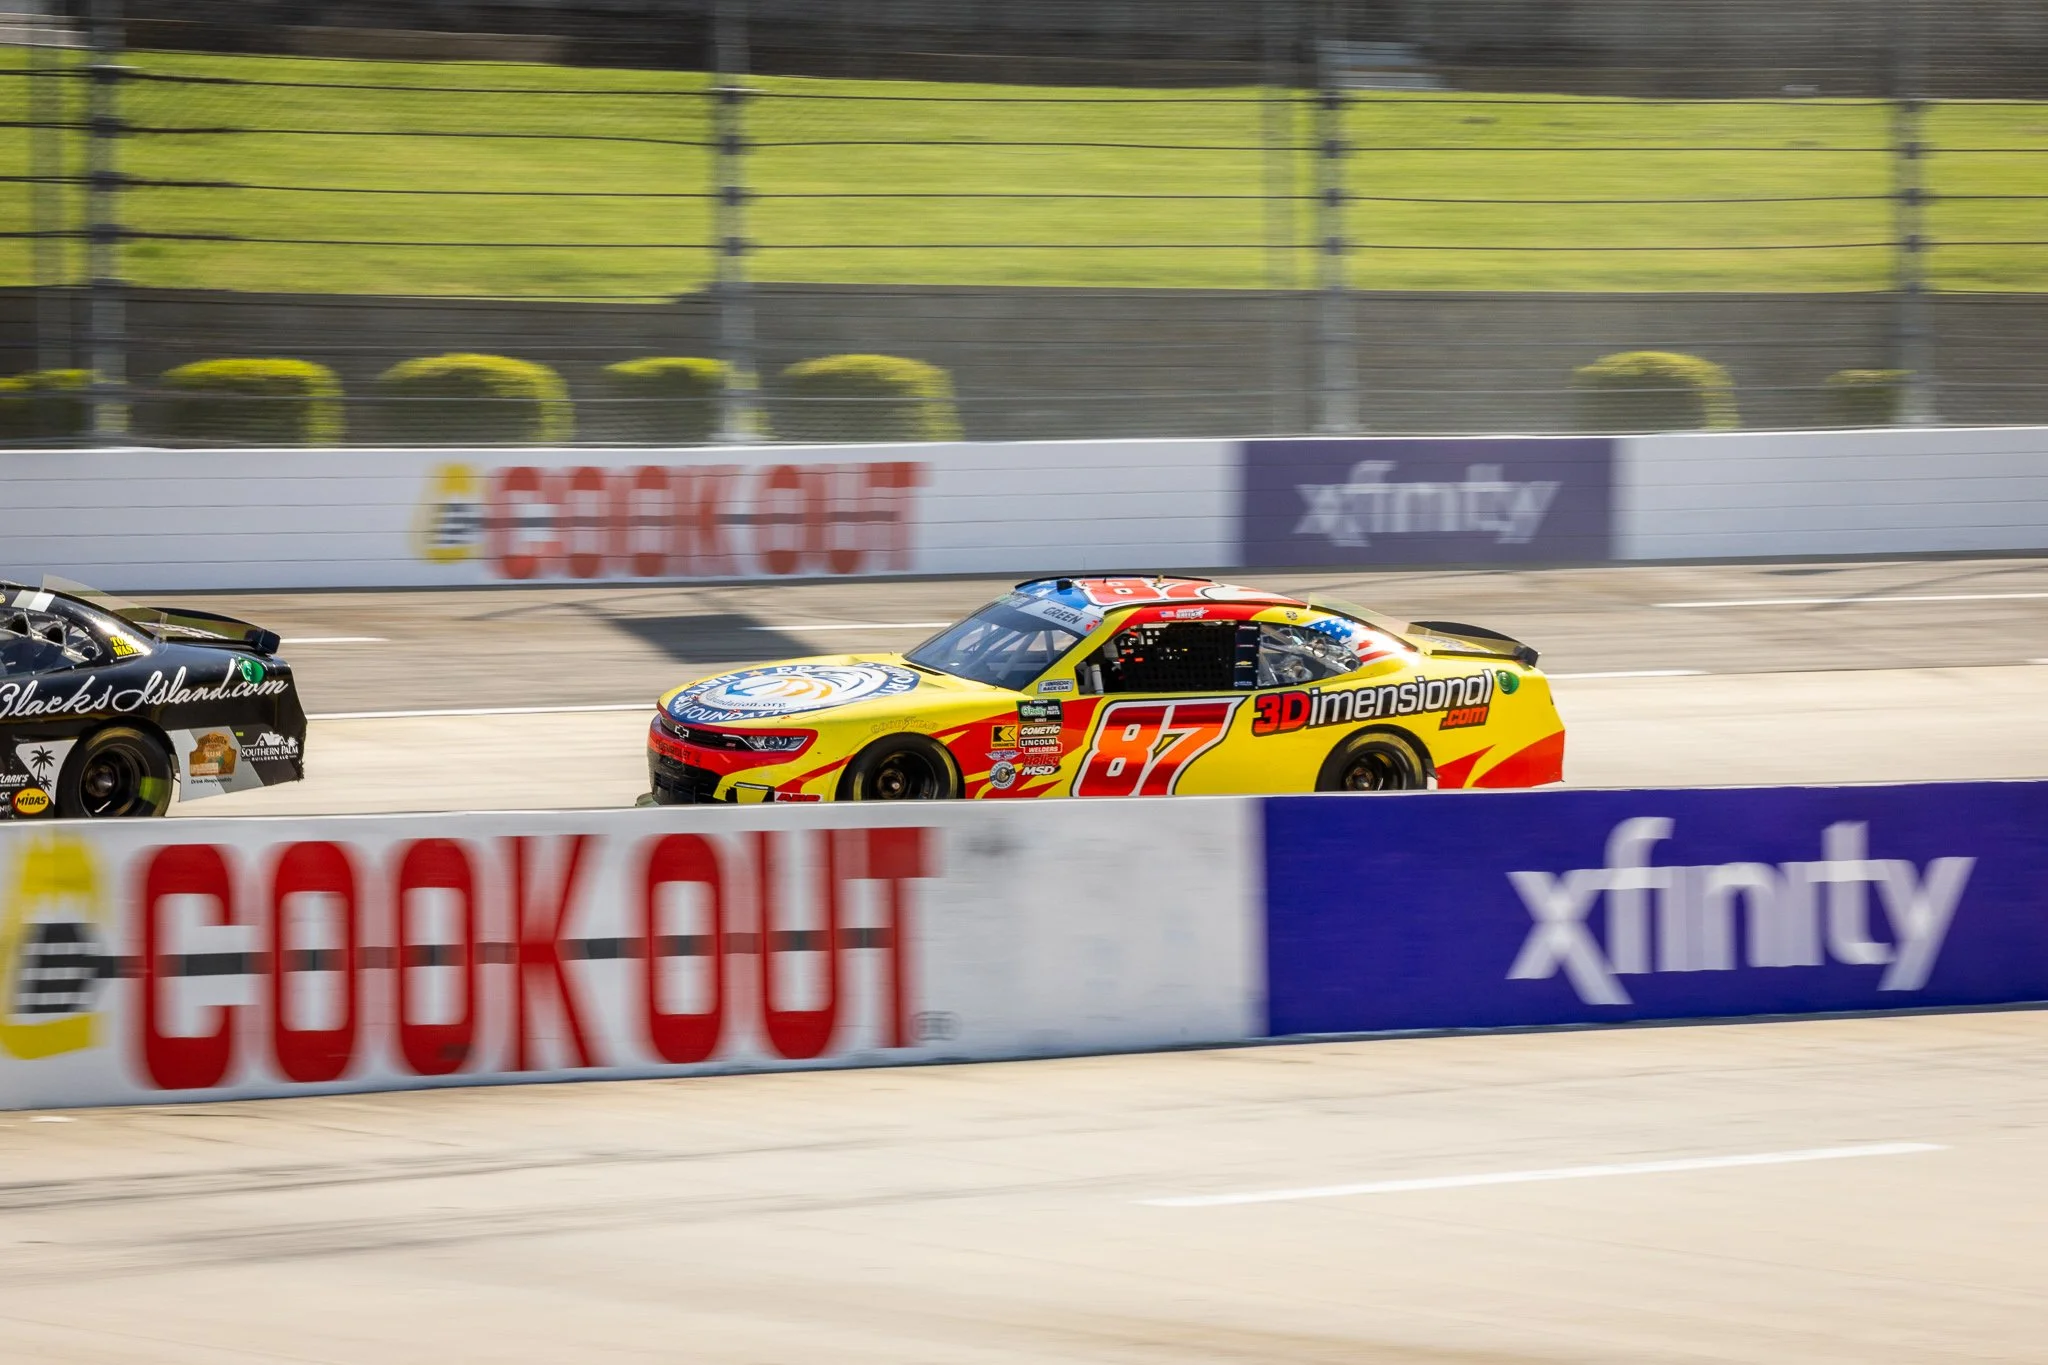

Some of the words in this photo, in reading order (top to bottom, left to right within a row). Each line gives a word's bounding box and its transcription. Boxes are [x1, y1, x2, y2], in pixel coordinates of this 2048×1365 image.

[1292, 460, 1564, 547] xfinity
[1043, 607, 1083, 624] GREEN
[1253, 669, 1494, 735] 3Dimensional
[1442, 707, 1488, 727] .com
[241, 748, 280, 757] SOUTHERN
[281, 745, 299, 754] PALM
[1073, 698, 1248, 796] 87
[1021, 766, 1056, 776] MSD
[1023, 755, 1061, 767] Holley
[1504, 817, 1979, 1004] xfinity
